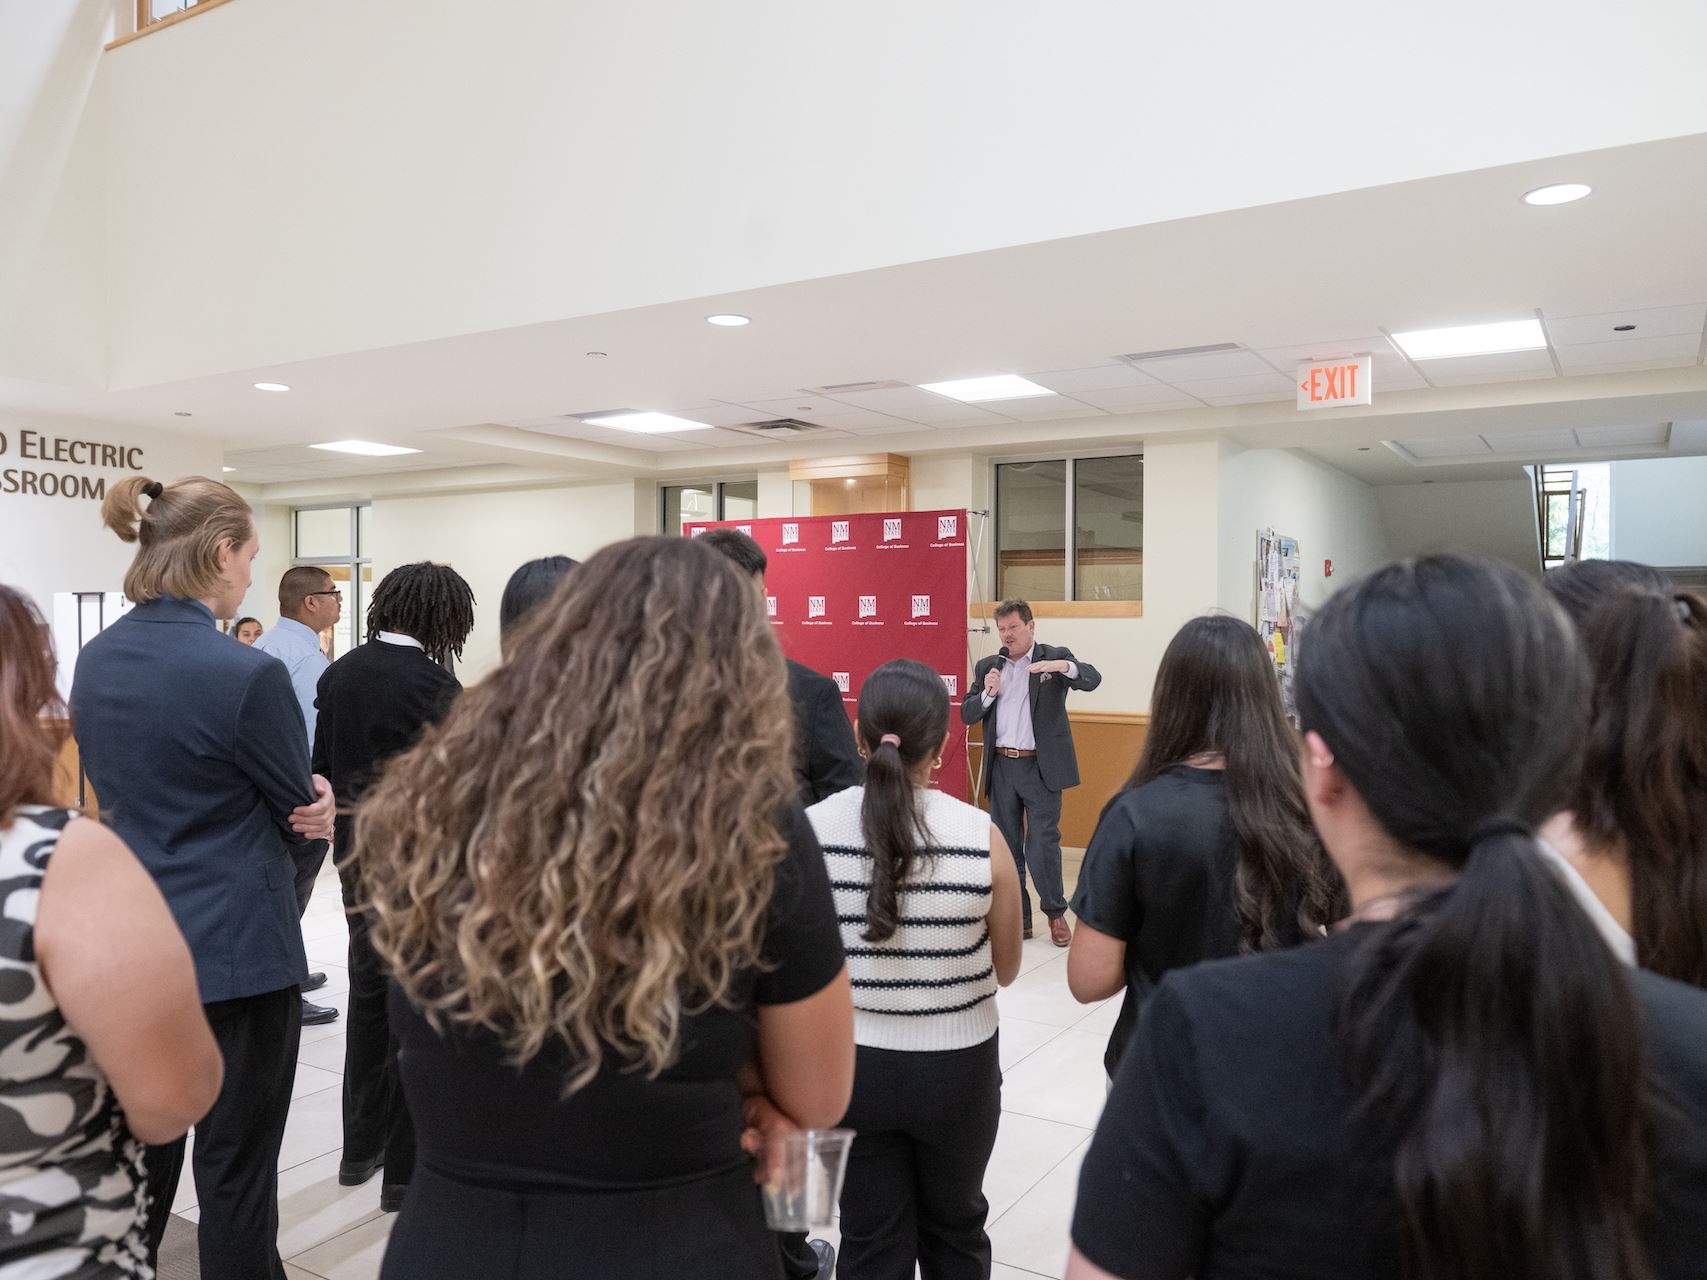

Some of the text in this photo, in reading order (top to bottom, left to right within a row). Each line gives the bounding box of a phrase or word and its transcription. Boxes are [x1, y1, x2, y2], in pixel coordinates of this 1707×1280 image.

[1310, 365, 1359, 401] EXIT
[20, 430, 144, 470] ELECTRIC
[0, 469, 105, 500] SROOM
[833, 524, 848, 532] NM
[885, 522, 900, 530] NM
[940, 519, 955, 528] NM
[810, 599, 824, 607] NM
[860, 599, 875, 607] NM
[913, 598, 928, 607] NM
